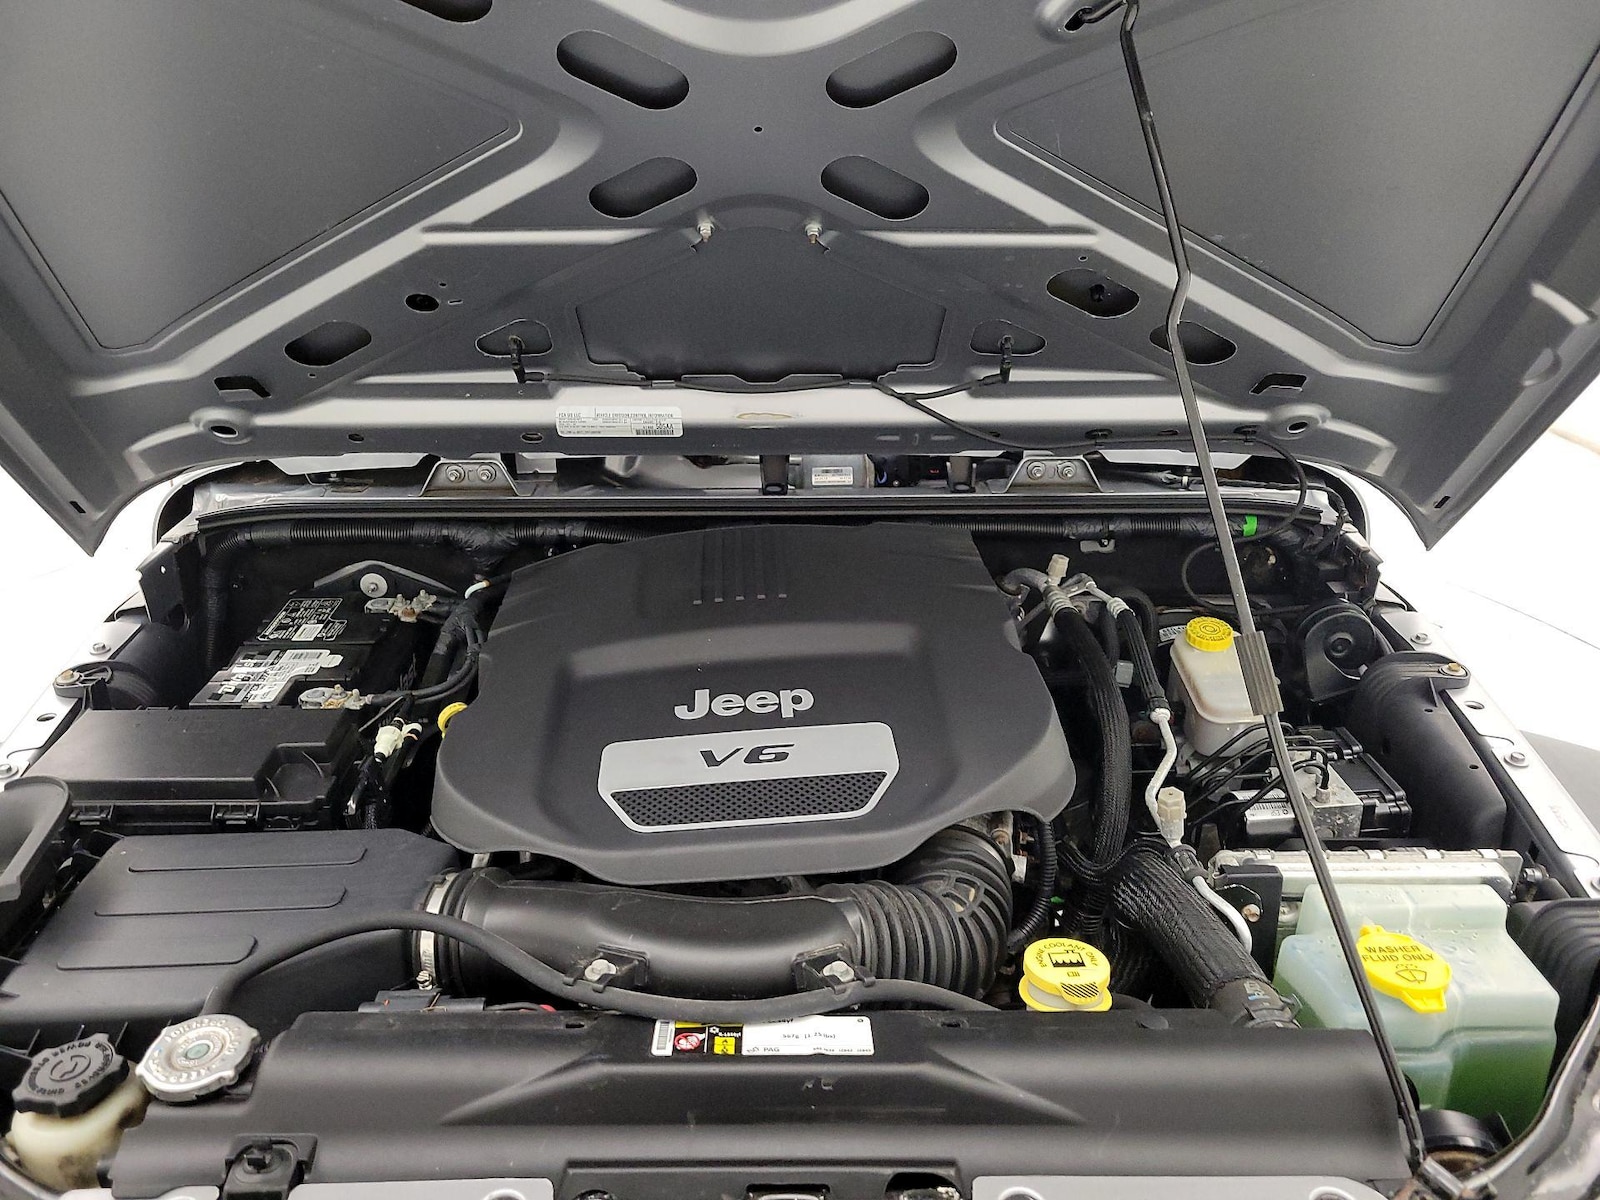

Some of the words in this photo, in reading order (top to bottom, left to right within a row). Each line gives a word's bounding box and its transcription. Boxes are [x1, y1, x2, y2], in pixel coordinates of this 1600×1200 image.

[674, 688, 815, 720] Jeep
[700, 743, 795, 768] V6
[1044, 941, 1086, 952] COOLANT
[1085, 951, 1098, 967] ONLY
[1361, 954, 1399, 963] FLUID
[1402, 953, 1435, 961] ONLY
[1363, 945, 1421, 954] WASHER
